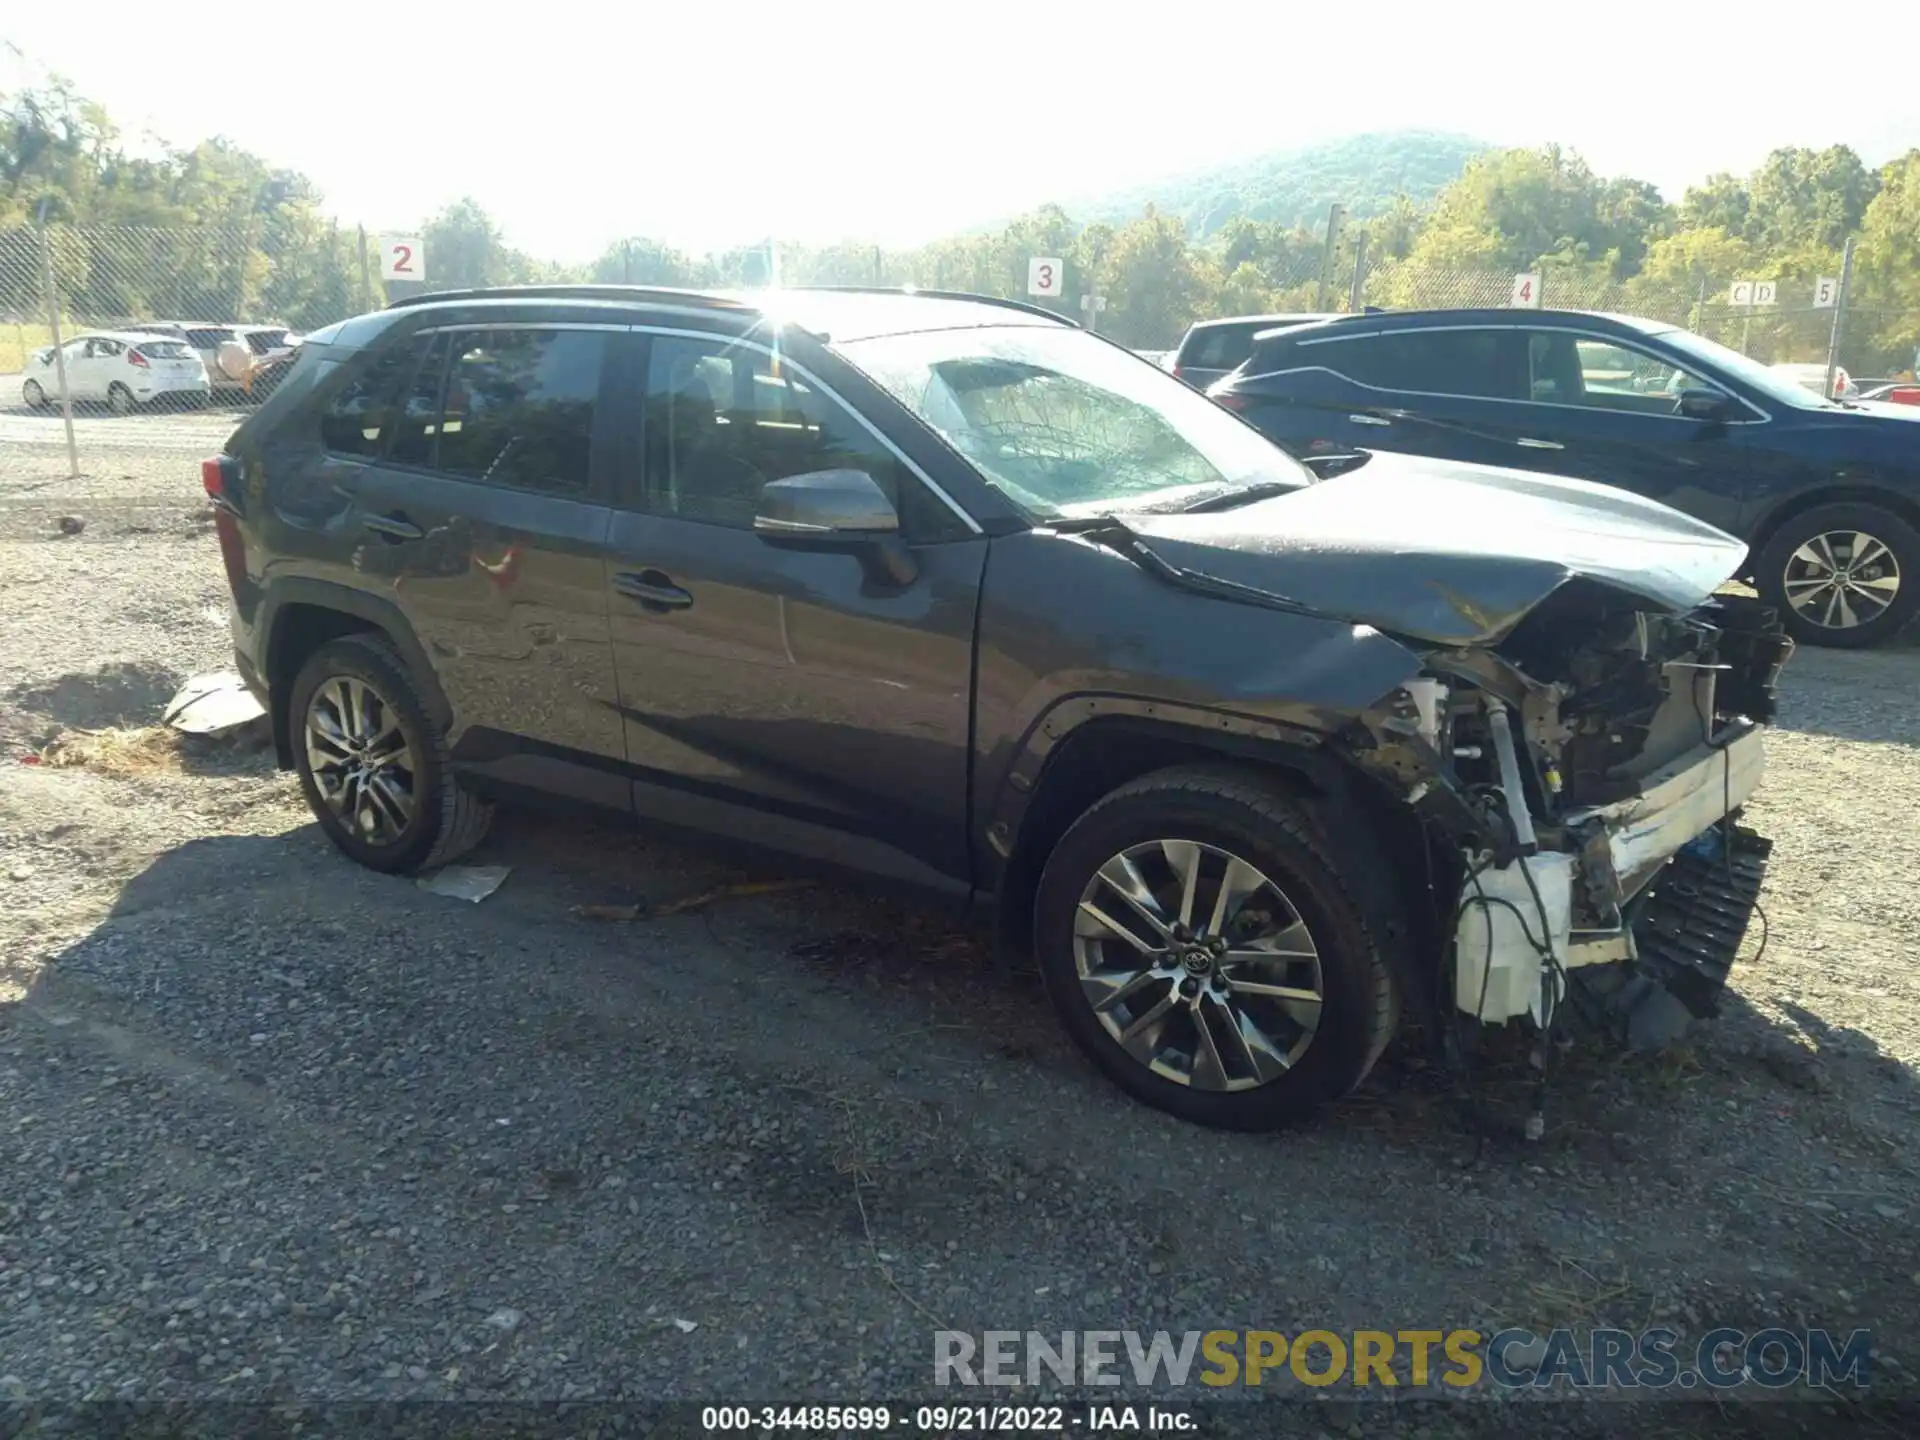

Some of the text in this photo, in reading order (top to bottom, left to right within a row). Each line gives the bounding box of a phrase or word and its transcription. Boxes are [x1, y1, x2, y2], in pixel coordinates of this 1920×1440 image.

[393, 245, 413, 272] 2
[1038, 265, 1053, 289] 3
[1519, 281, 1531, 302] 4
[1734, 286, 1747, 301] C
[1758, 286, 1771, 301] D
[1819, 284, 1830, 302] 5
